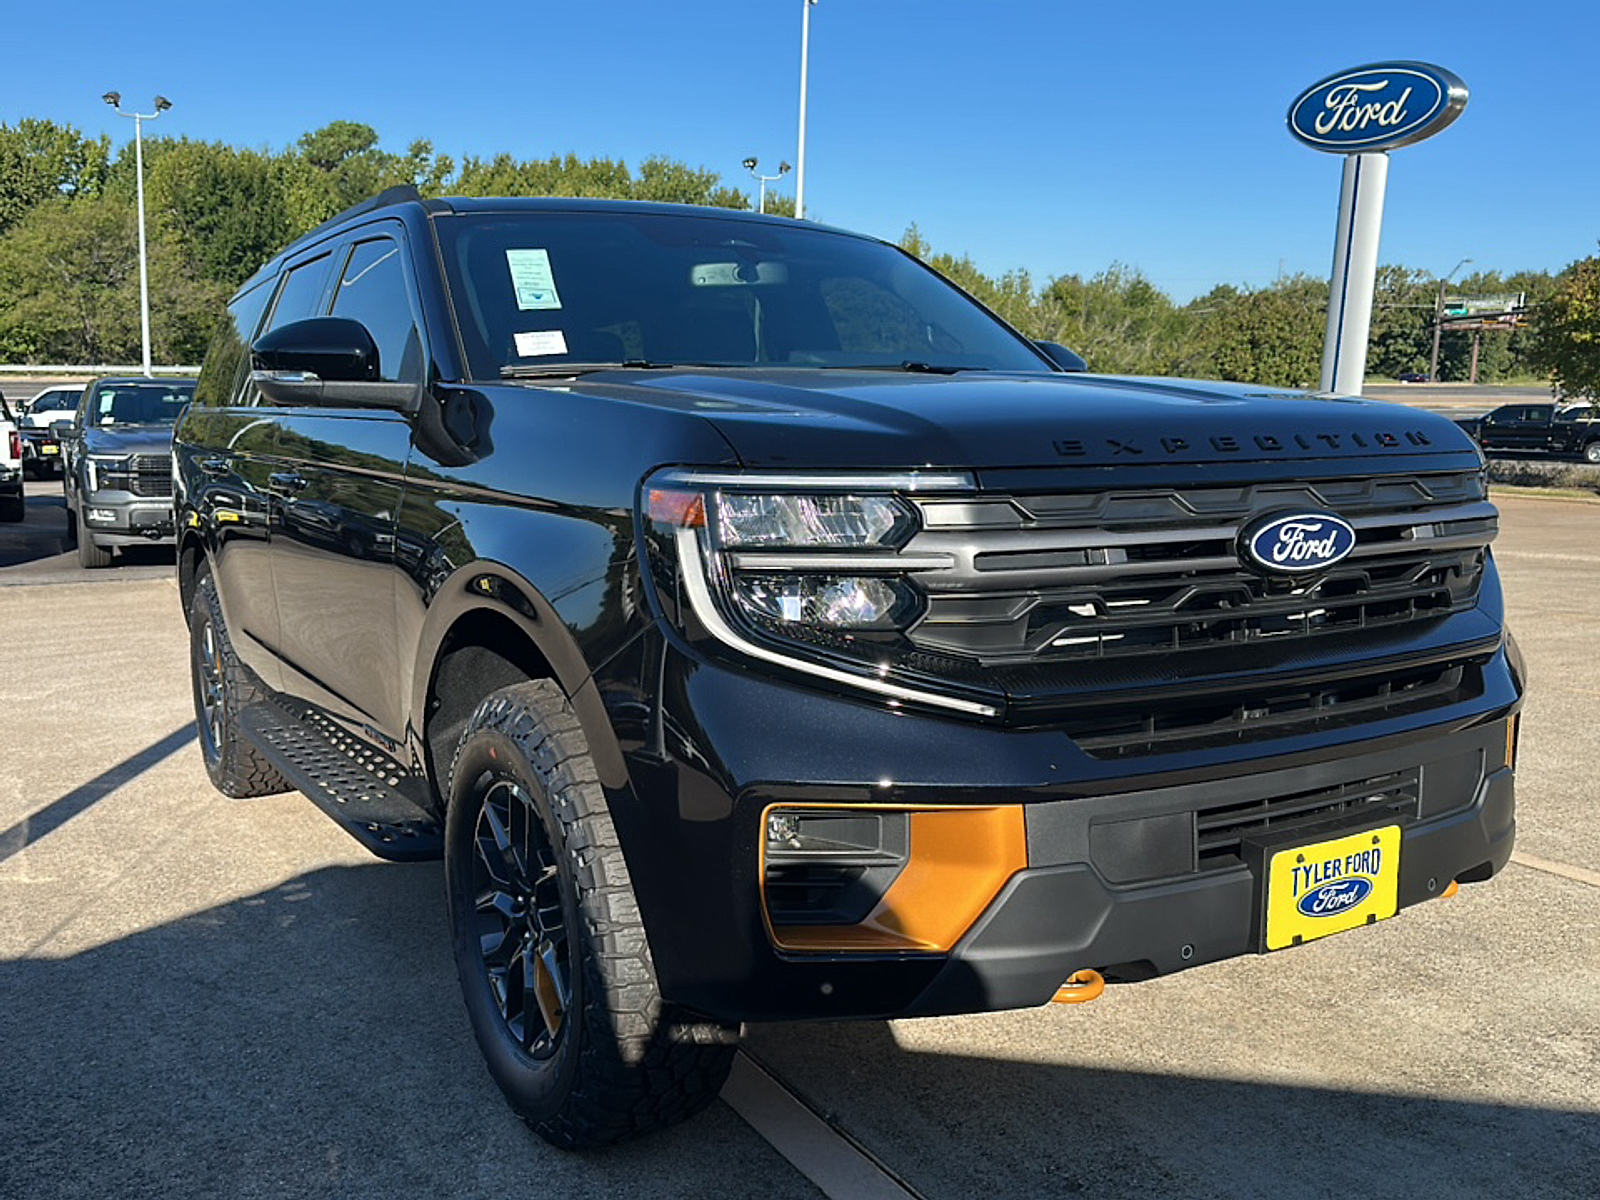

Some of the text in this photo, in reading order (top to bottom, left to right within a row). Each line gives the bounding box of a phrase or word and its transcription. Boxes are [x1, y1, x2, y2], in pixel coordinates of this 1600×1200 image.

[1315, 80, 1412, 134] Ford
[1052, 431, 1431, 456] EXPEDITION
[1273, 523, 1337, 561] Ford
[1291, 848, 1380, 897] TYLER FORD
[1313, 883, 1359, 912] Ford
